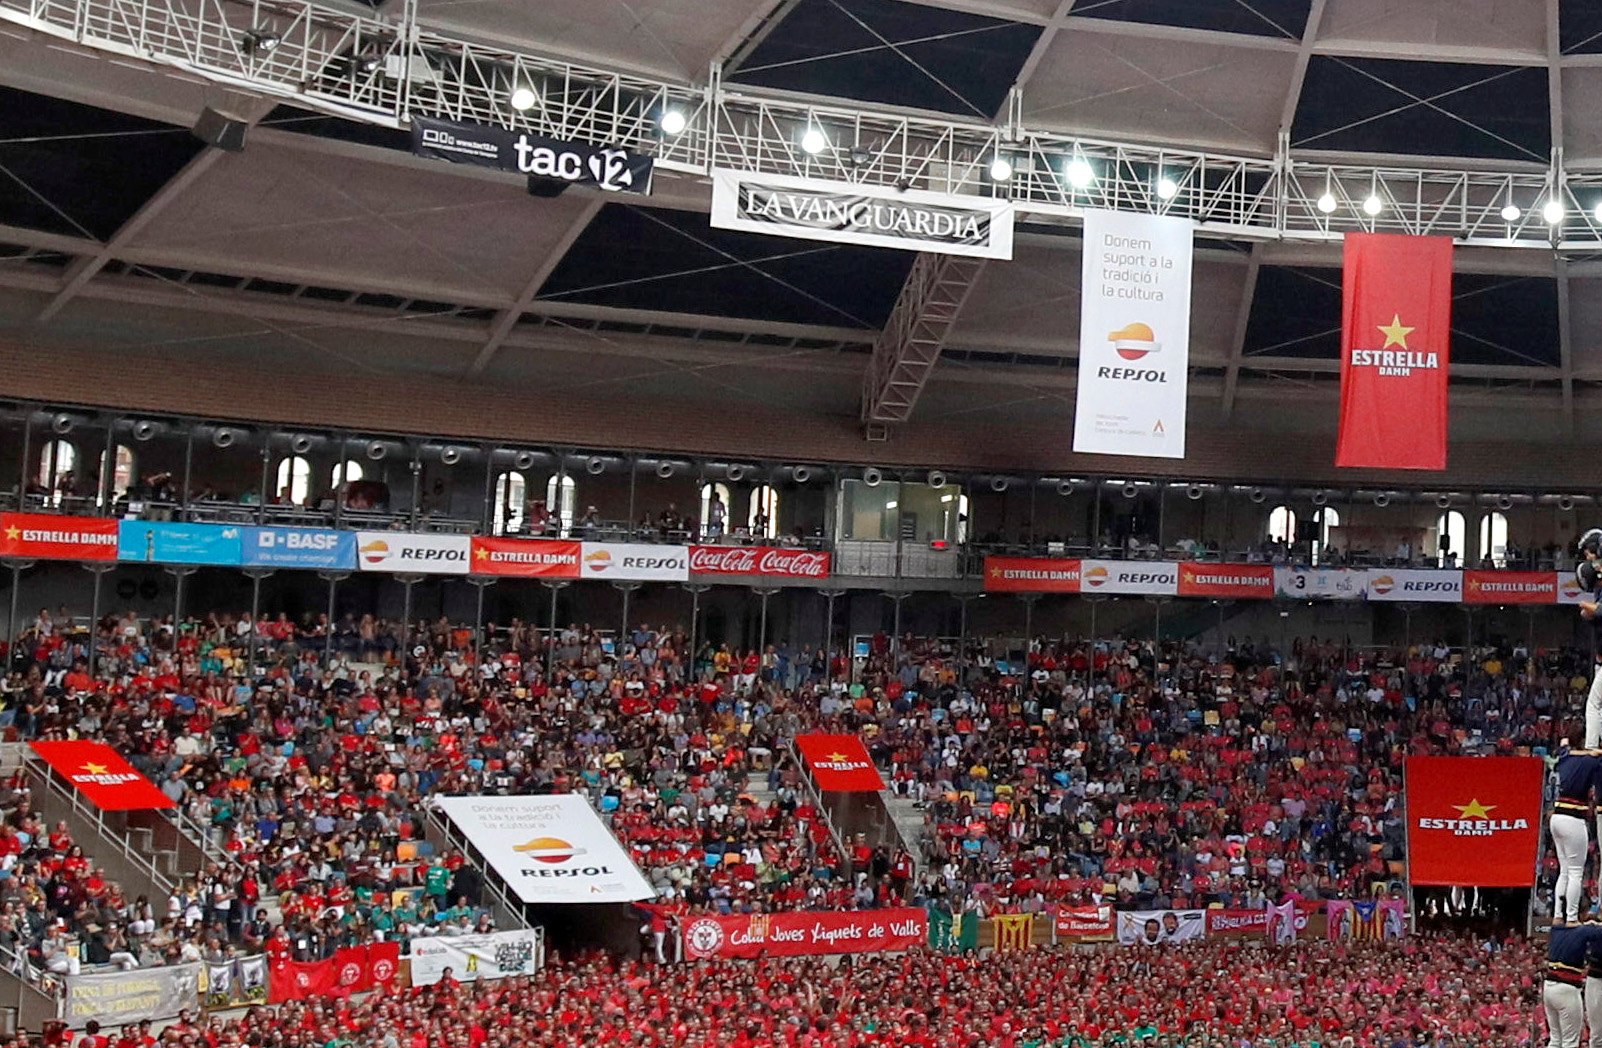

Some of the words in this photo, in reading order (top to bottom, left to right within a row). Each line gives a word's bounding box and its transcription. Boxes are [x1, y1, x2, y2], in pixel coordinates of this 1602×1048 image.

[785, 195, 984, 240] VANGUARDIA
[1104, 234, 1151, 250] Donem
[1103, 252, 1145, 267] suport
[1150, 258, 1157, 267] a
[1161, 256, 1173, 268] la
[1103, 269, 1151, 284] tradició
[1102, 284, 1114, 296] la
[1118, 287, 1164, 301] cultura
[1352, 349, 1438, 368] ESTRELLA
[1098, 367, 1167, 382] REPSOL
[1379, 367, 1410, 376] DAMM
[22, 529, 79, 543] ESTRELLA
[81, 532, 118, 545] DAMM
[287, 532, 338, 549] BASF
[401, 548, 466, 561] REPSOL
[490, 551, 541, 563] ESTRELLA
[543, 554, 576, 565] DAMM
[690, 548, 756, 571] Coca-Cola
[623, 556, 686, 570] REPSOL
[759, 550, 826, 575] Coca-Cola
[1004, 570, 1049, 579] ESTRELLA
[1050, 570, 1079, 580] DAMM
[1118, 573, 1176, 584] REPSOL
[1196, 575, 1240, 585] ESTRELLA
[1241, 576, 1269, 586] DAMM
[1404, 581, 1460, 592] REPSOL
[1481, 582, 1524, 592] ESTRELLA
[1525, 583, 1553, 592] DAMM
[72, 773, 140, 783] ESTRELLA
[1419, 818, 1528, 830] ESTRELLA
[521, 867, 614, 878] REPSOL
[771, 926, 804, 942] Joves
[812, 922, 861, 945] Xiquets
[868, 923, 884, 937] de
[890, 919, 921, 936] Valls
